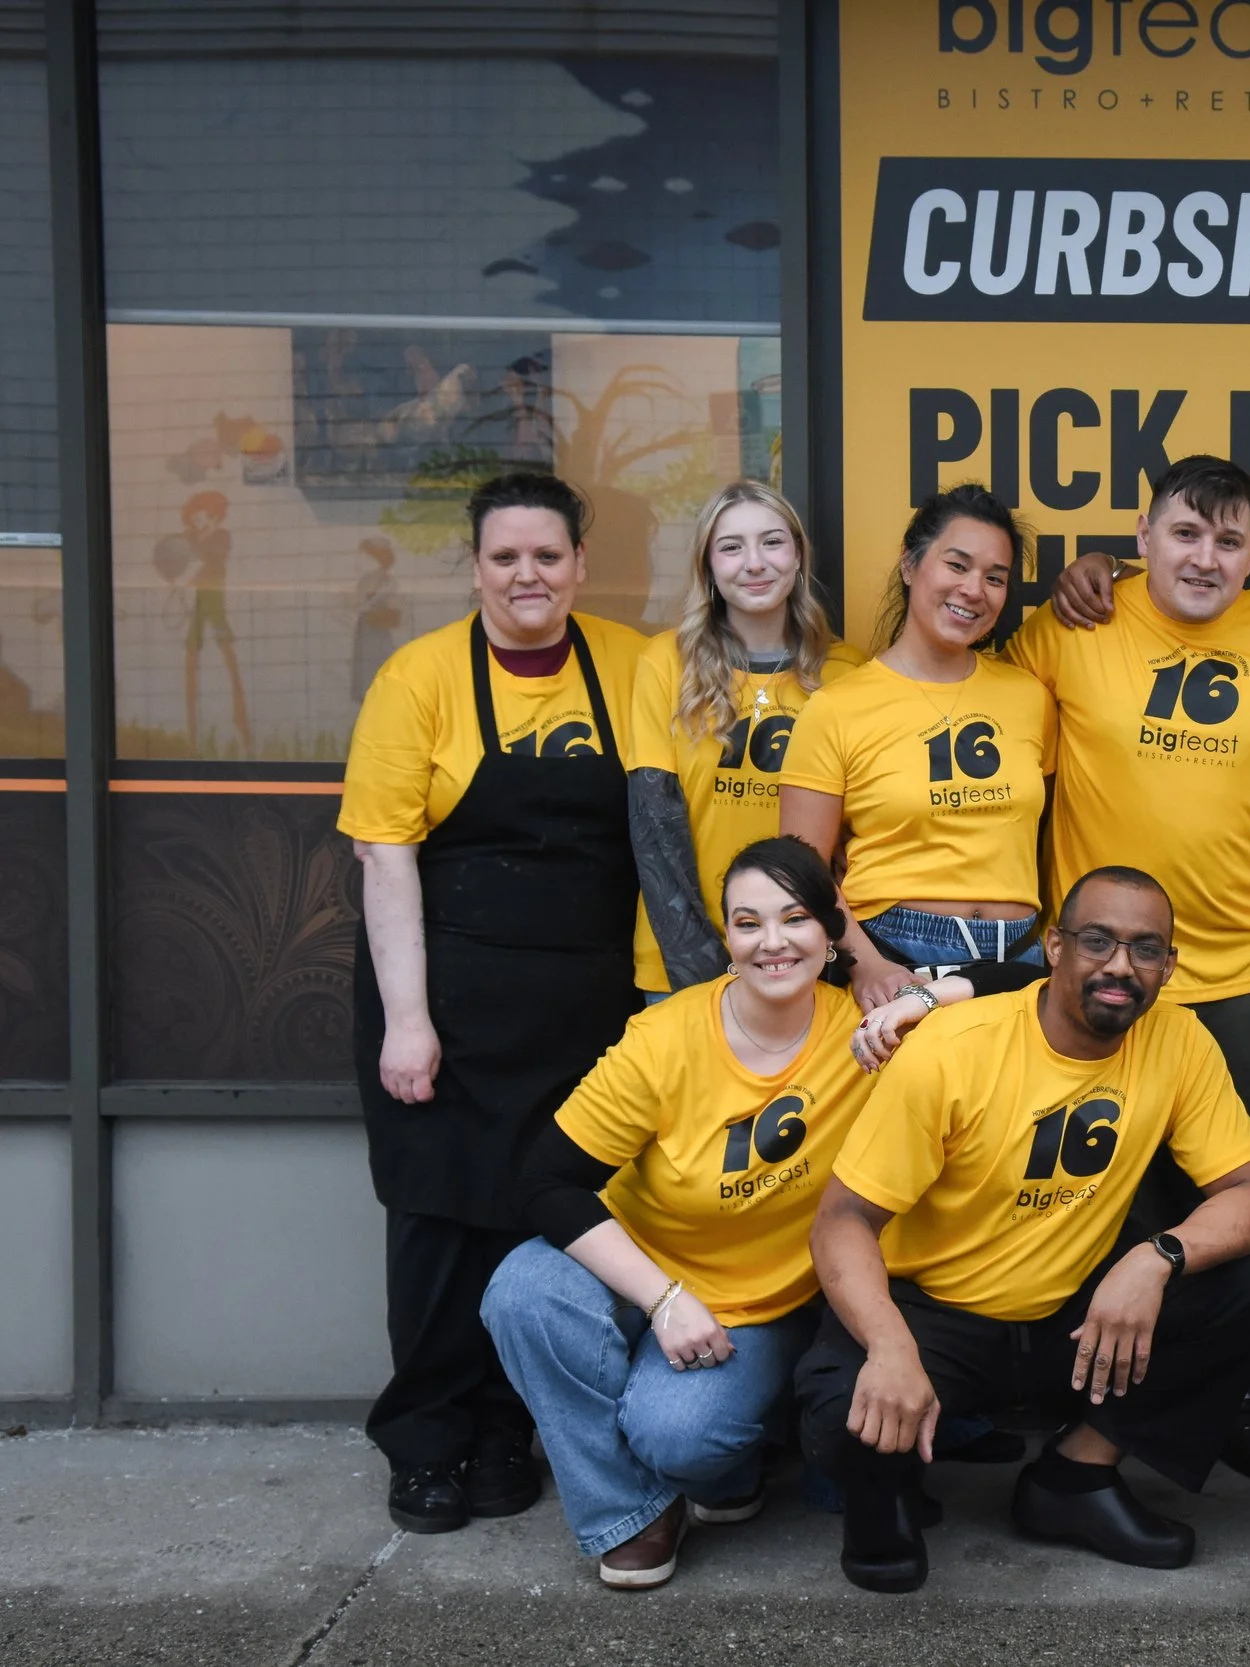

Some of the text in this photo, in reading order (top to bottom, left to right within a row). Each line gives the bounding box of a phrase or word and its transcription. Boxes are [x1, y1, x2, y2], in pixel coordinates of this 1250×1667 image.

[910, 387, 1188, 512] PICK
[1144, 658, 1239, 725] 16
[717, 715, 796, 773] 16
[924, 721, 1001, 782] 16
[1140, 725, 1239, 754] bigfeast
[713, 798, 777, 808] BISTRO+RET
[715, 777, 779, 798] bigfea
[929, 783, 1011, 808] bigfeast
[722, 1095, 806, 1174] 16
[1023, 1098, 1120, 1180] 16
[720, 1158, 810, 1199] bigfeast
[1016, 1184, 1097, 1211] bigfeas
